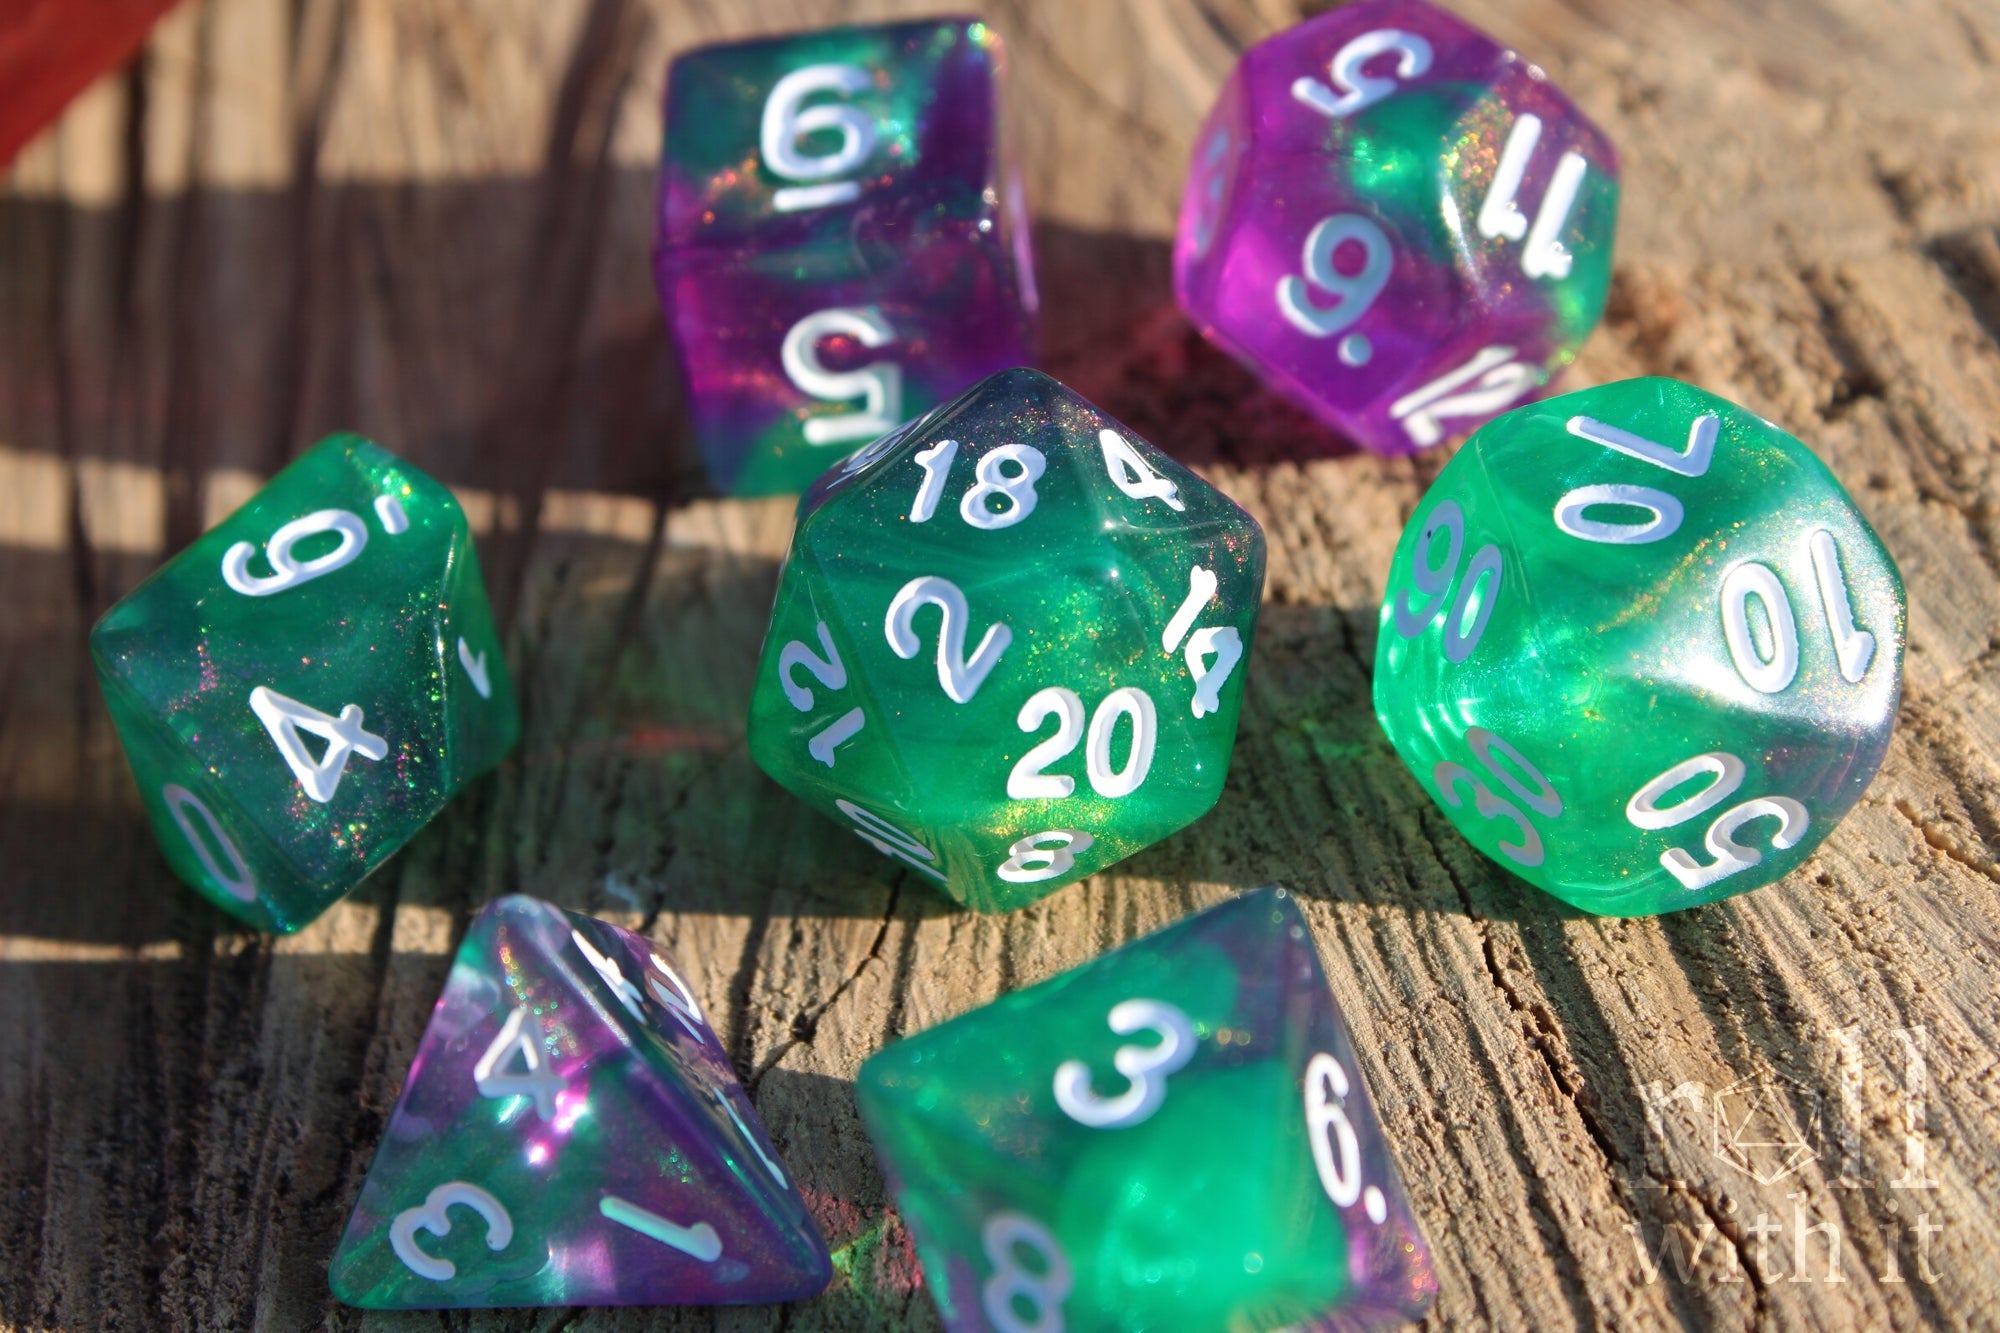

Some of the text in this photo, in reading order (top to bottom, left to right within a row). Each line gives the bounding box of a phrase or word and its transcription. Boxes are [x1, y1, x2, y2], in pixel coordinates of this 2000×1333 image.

[1291, 28, 1434, 118] 5
[760, 62, 876, 212] 6
[1477, 113, 1587, 280] 11
[781, 307, 903, 446] 5
[1388, 344, 1537, 447] 12
[909, 439, 1047, 530] 18
[1099, 428, 1186, 513] 4
[1554, 415, 1721, 544] 70
[885, 575, 1014, 704] 2
[1162, 565, 1243, 719] 14
[1394, 499, 1503, 664] 90
[1720, 529, 1877, 694] 10
[249, 686, 388, 803] 4
[778, 621, 866, 769] 12
[1006, 686, 1158, 800] 20
[162, 783, 257, 903] 0
[997, 828, 1095, 883] 8
[1432, 725, 1564, 868] 30
[1626, 751, 1810, 890] 50
[473, 1006, 568, 1122] 4
[1053, 998, 1198, 1129] 3
[389, 1180, 514, 1281] 3
[599, 1195, 723, 1263] 1
[982, 1208, 1074, 1333] 8
